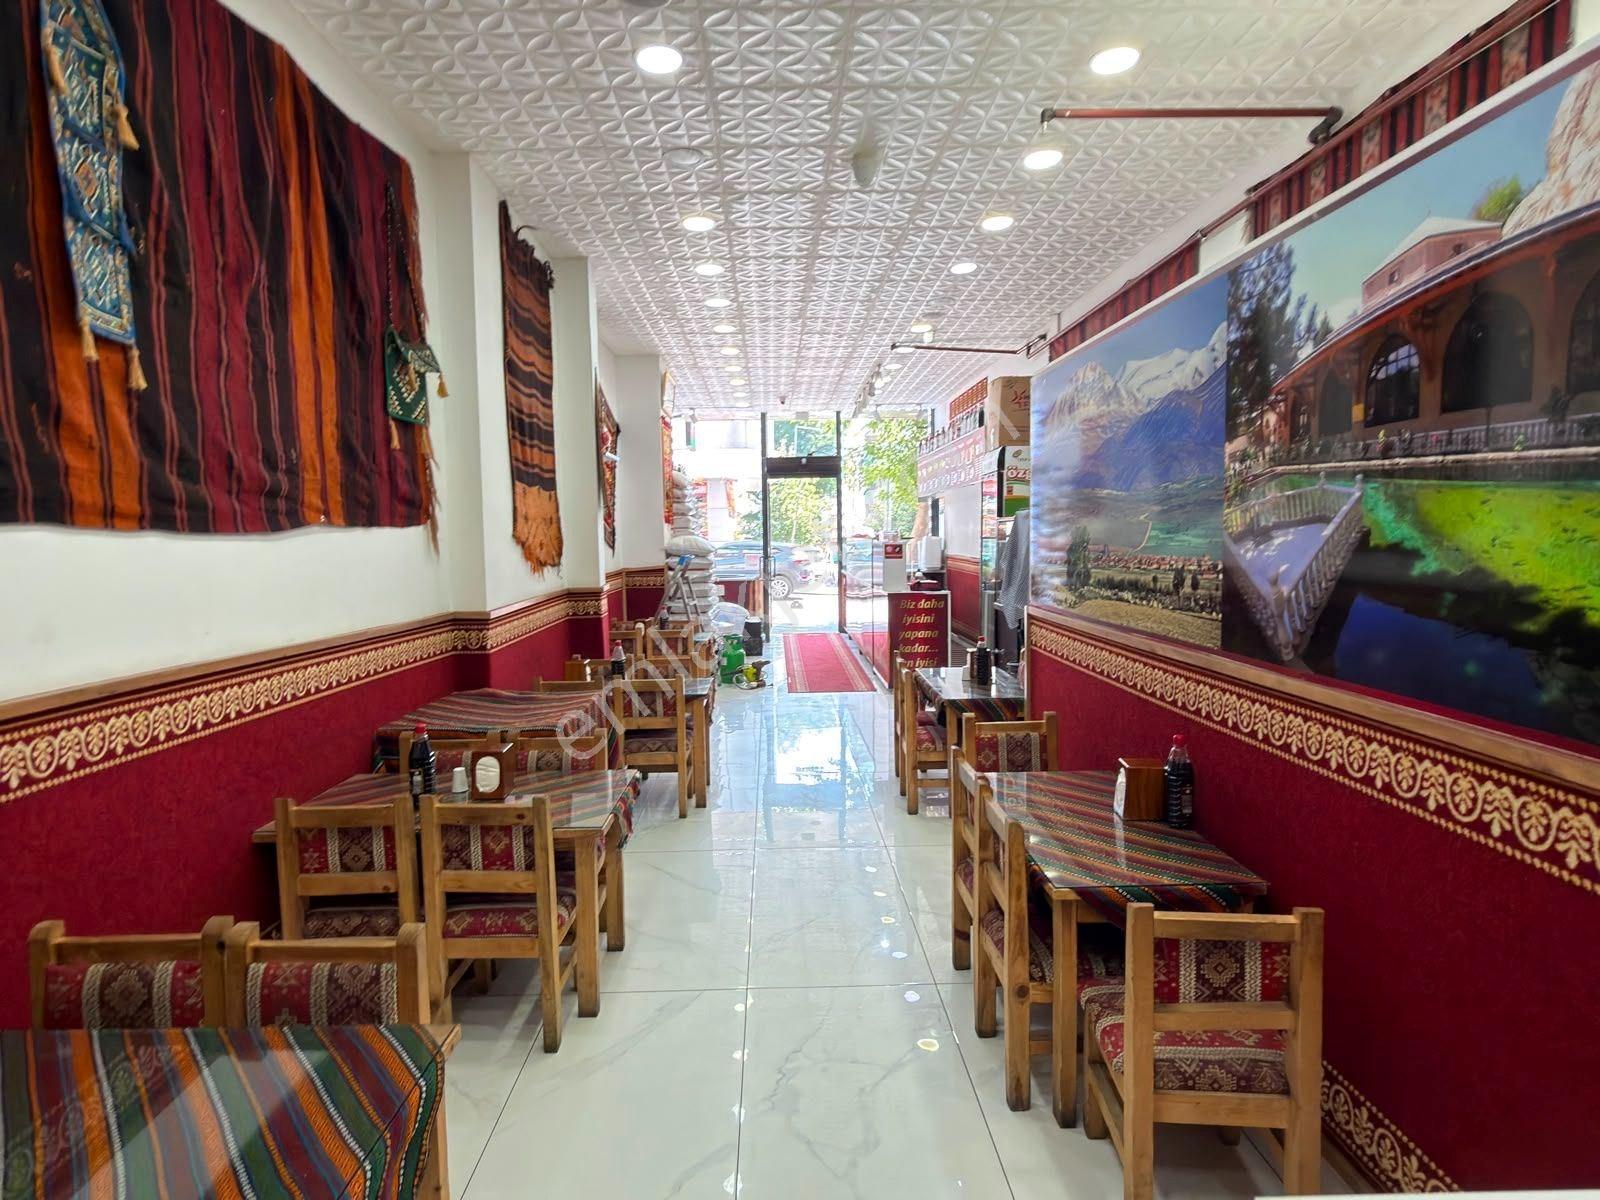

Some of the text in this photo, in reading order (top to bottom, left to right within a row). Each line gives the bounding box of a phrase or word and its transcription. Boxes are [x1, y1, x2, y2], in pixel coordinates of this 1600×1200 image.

[899, 598, 945, 609] Biz daha
[902, 613, 935, 625] iyisini
[898, 630, 939, 640] yapana
[915, 657, 938, 668] iyisi
